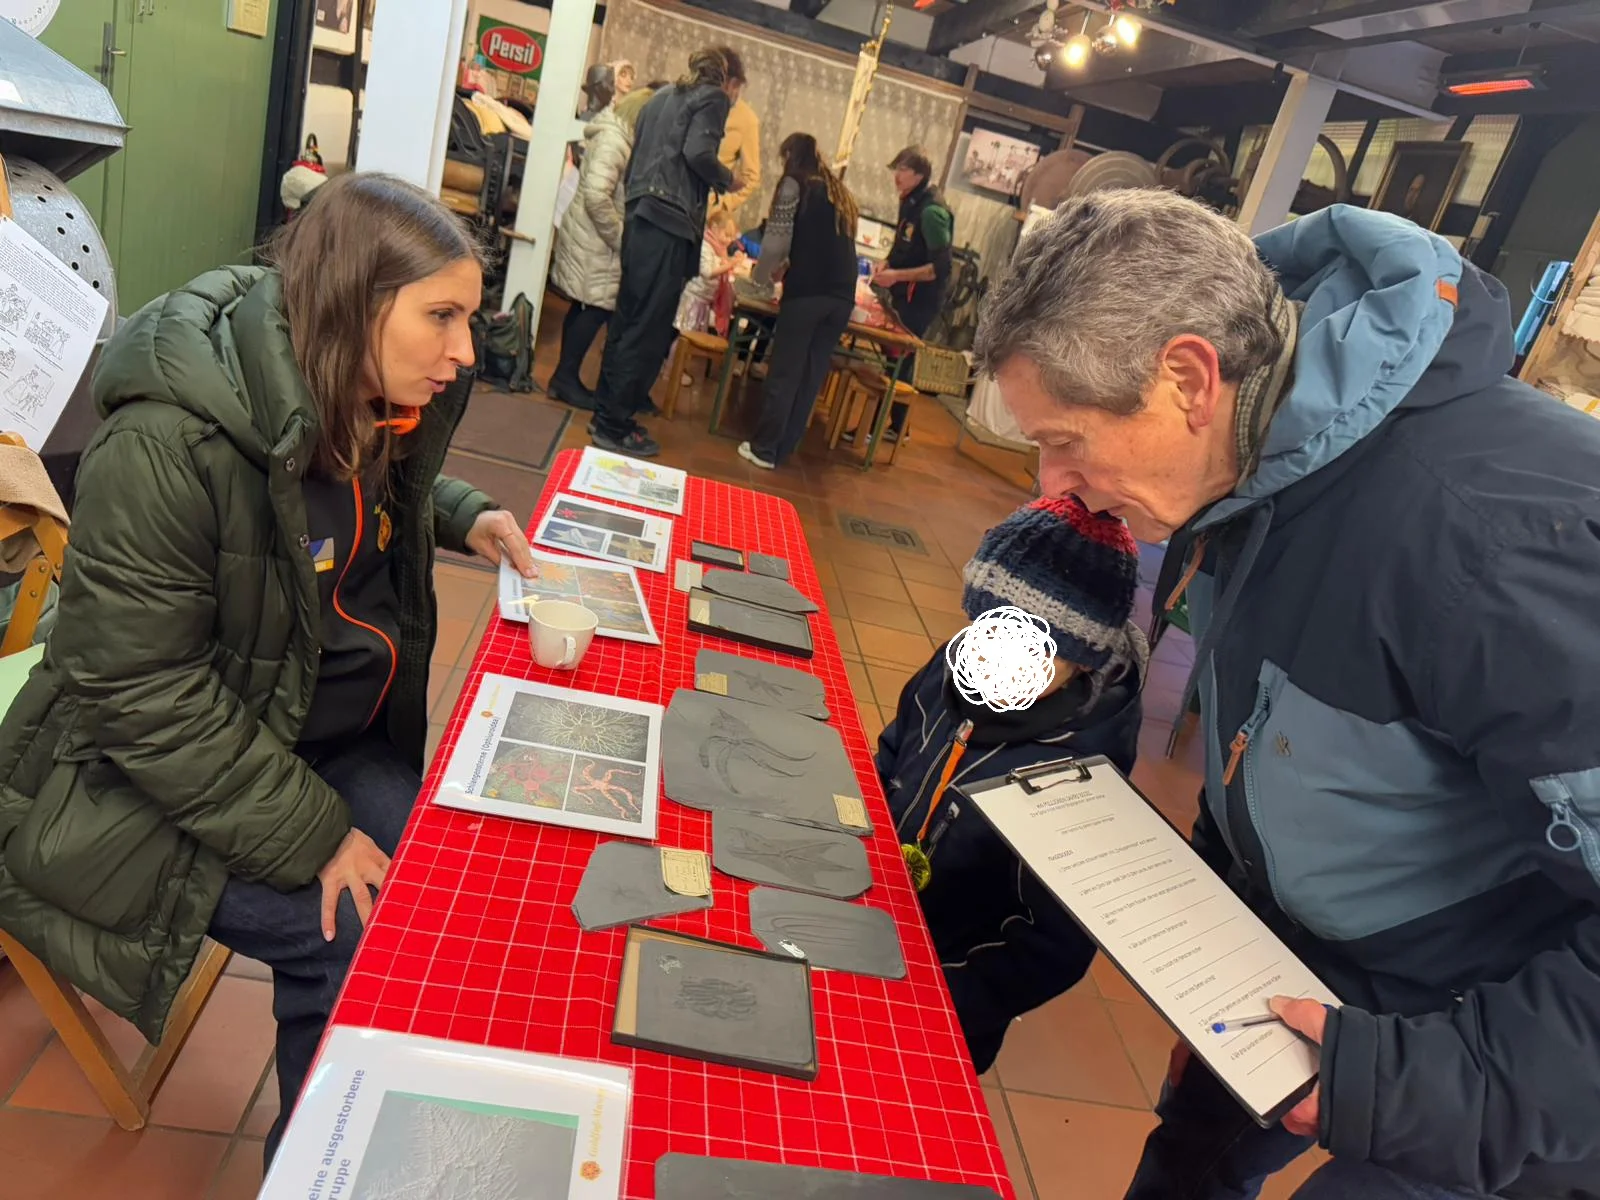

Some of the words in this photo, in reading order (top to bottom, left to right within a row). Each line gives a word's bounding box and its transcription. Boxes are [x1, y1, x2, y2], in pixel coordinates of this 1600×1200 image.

[488, 32, 535, 65] Persil
[465, 752, 487, 794] Schlangensterne
[308, 1169, 328, 1200] eine
[321, 1069, 365, 1166] ausgestorbene
